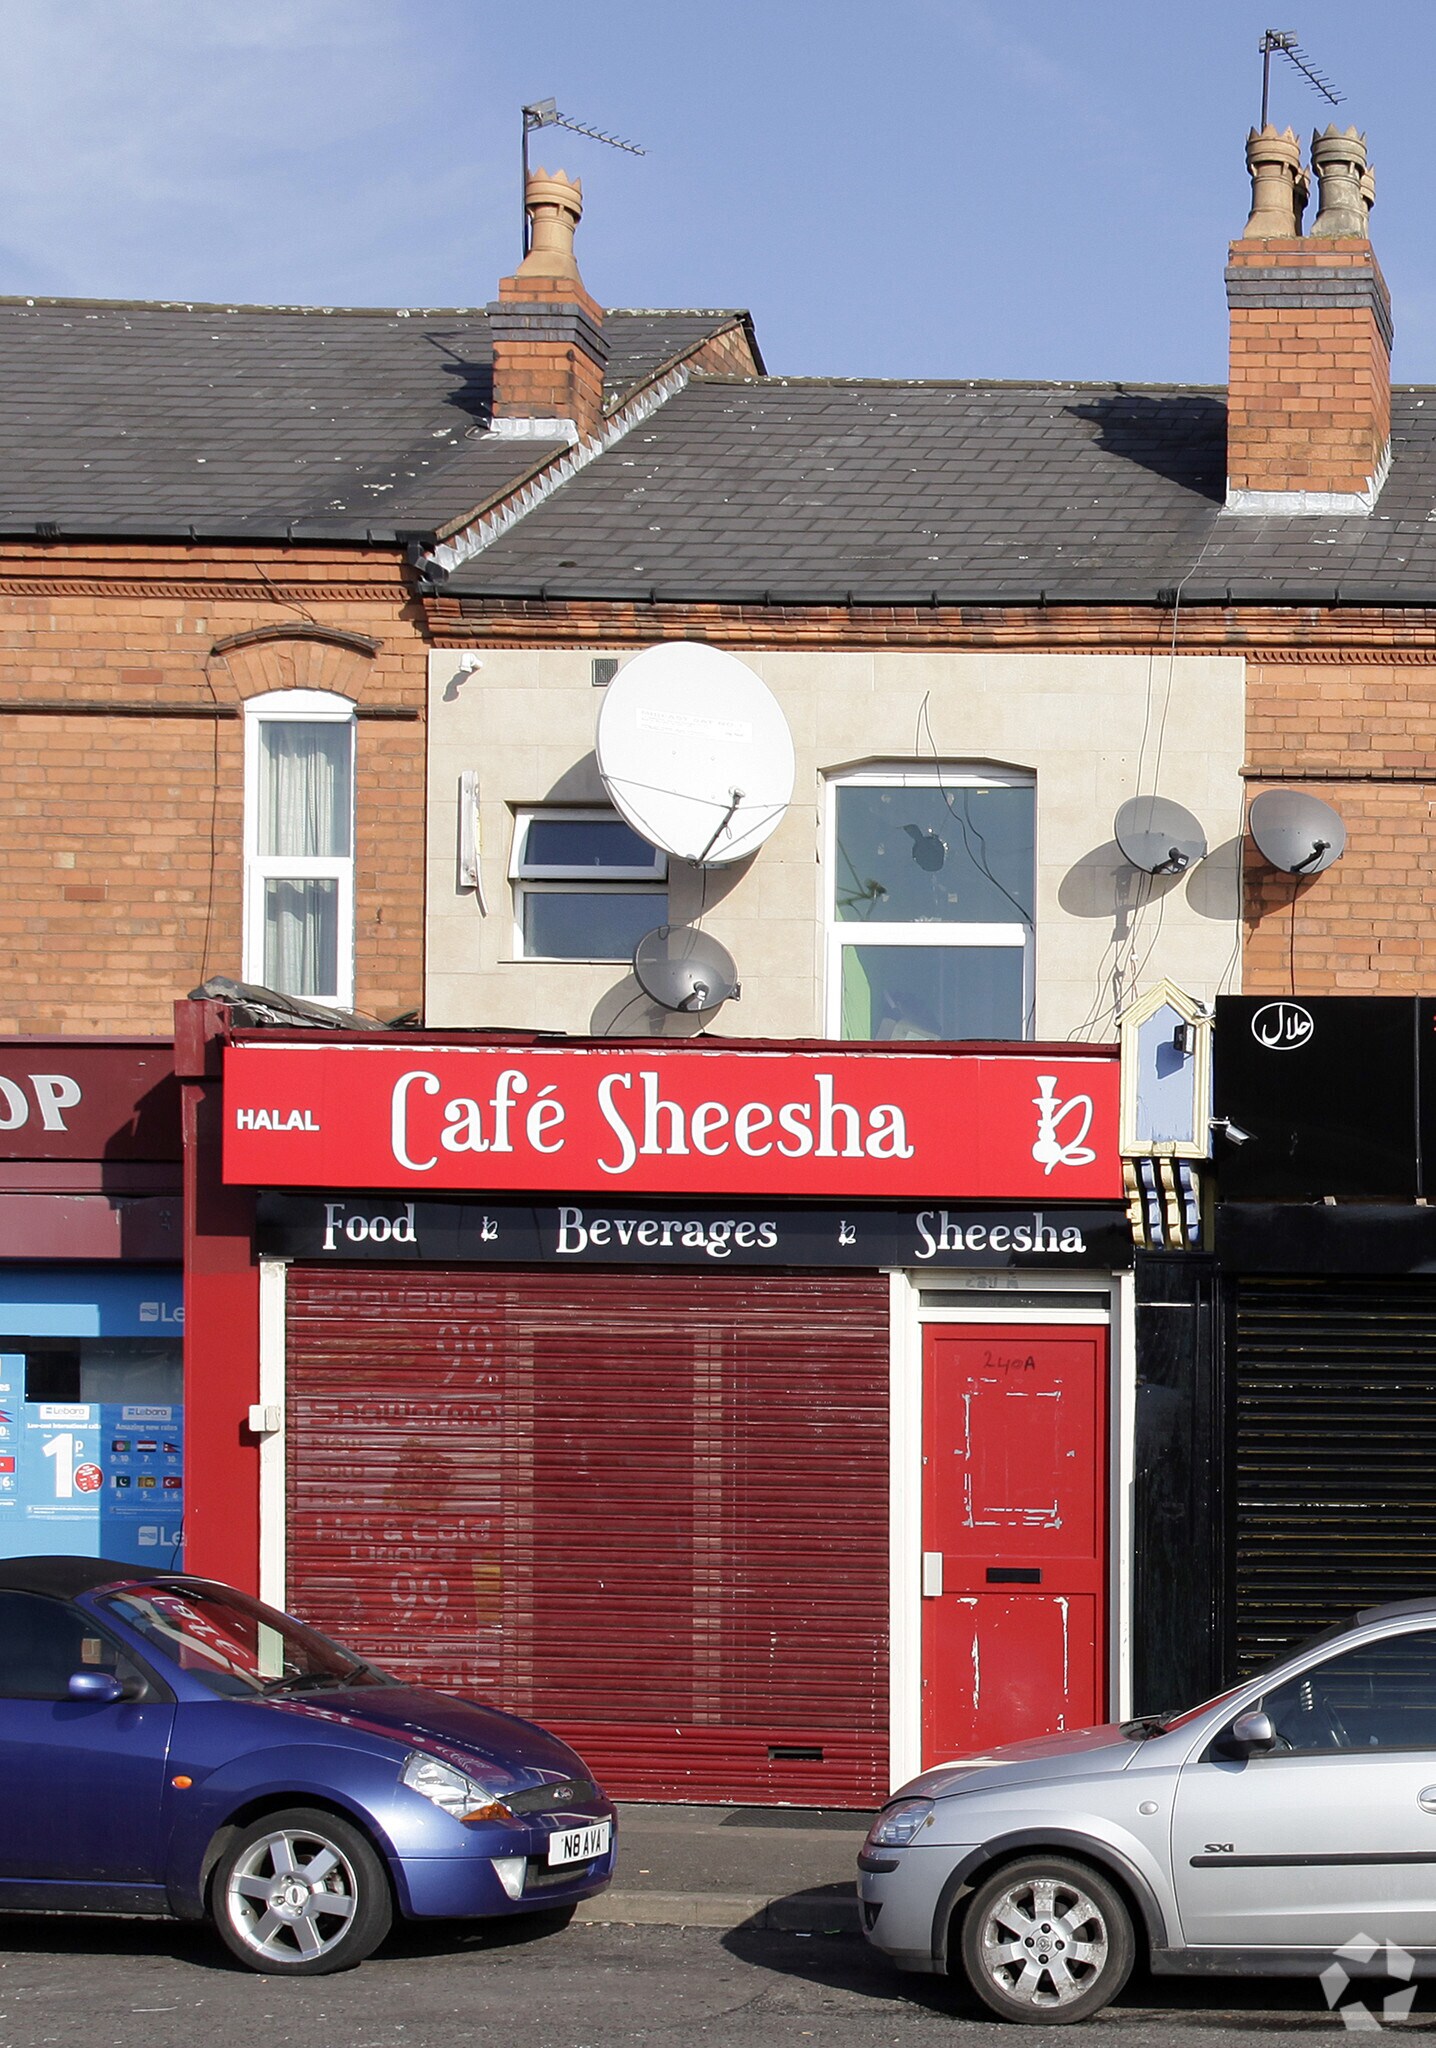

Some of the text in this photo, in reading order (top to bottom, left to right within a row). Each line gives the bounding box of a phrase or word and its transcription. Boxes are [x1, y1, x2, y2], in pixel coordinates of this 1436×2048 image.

[1261, 1004, 1311, 1045] حلال
[236, 1108, 320, 1131] HALAL
[391, 1069, 915, 1174] Café Sheesha
[322, 1203, 418, 1251] Food
[555, 1206, 778, 1258] Beverages
[914, 1210, 1087, 1260] Sheesha
[983, 1350, 1035, 1376] 240A
[564, 1828, 601, 1859] N8 AVA
